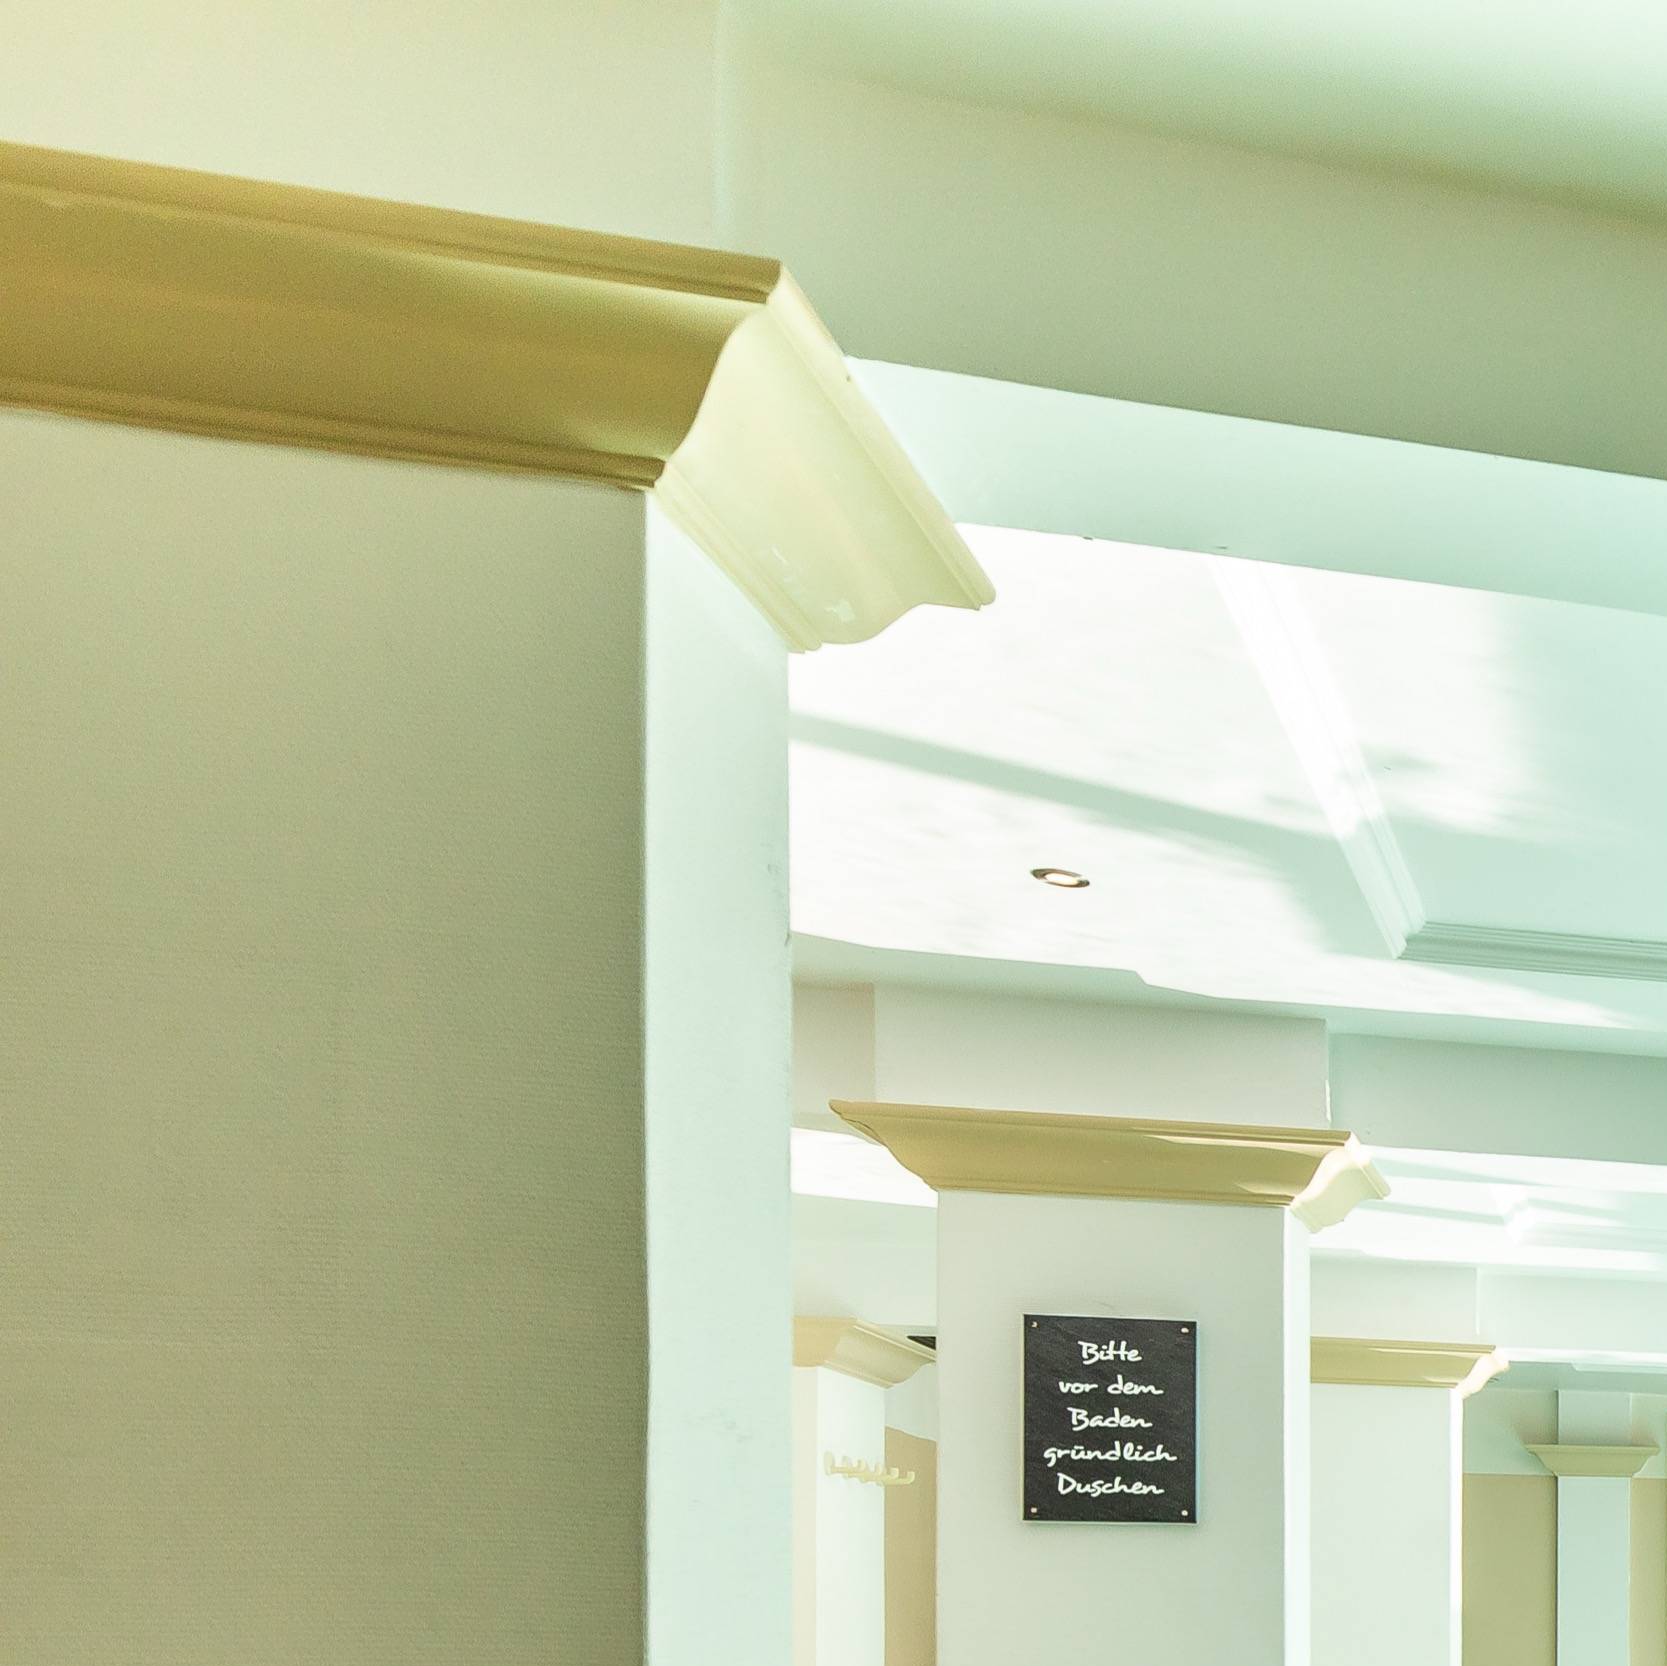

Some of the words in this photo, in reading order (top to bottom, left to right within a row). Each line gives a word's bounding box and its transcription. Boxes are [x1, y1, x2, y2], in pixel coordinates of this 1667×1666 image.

[1077, 1340, 1143, 1365] Bitte
[1058, 1380, 1099, 1394] vor
[1106, 1374, 1165, 1395] dem
[1066, 1406, 1153, 1431] Baden
[1043, 1440, 1178, 1468] gründlich
[1056, 1472, 1165, 1497] Duschen
